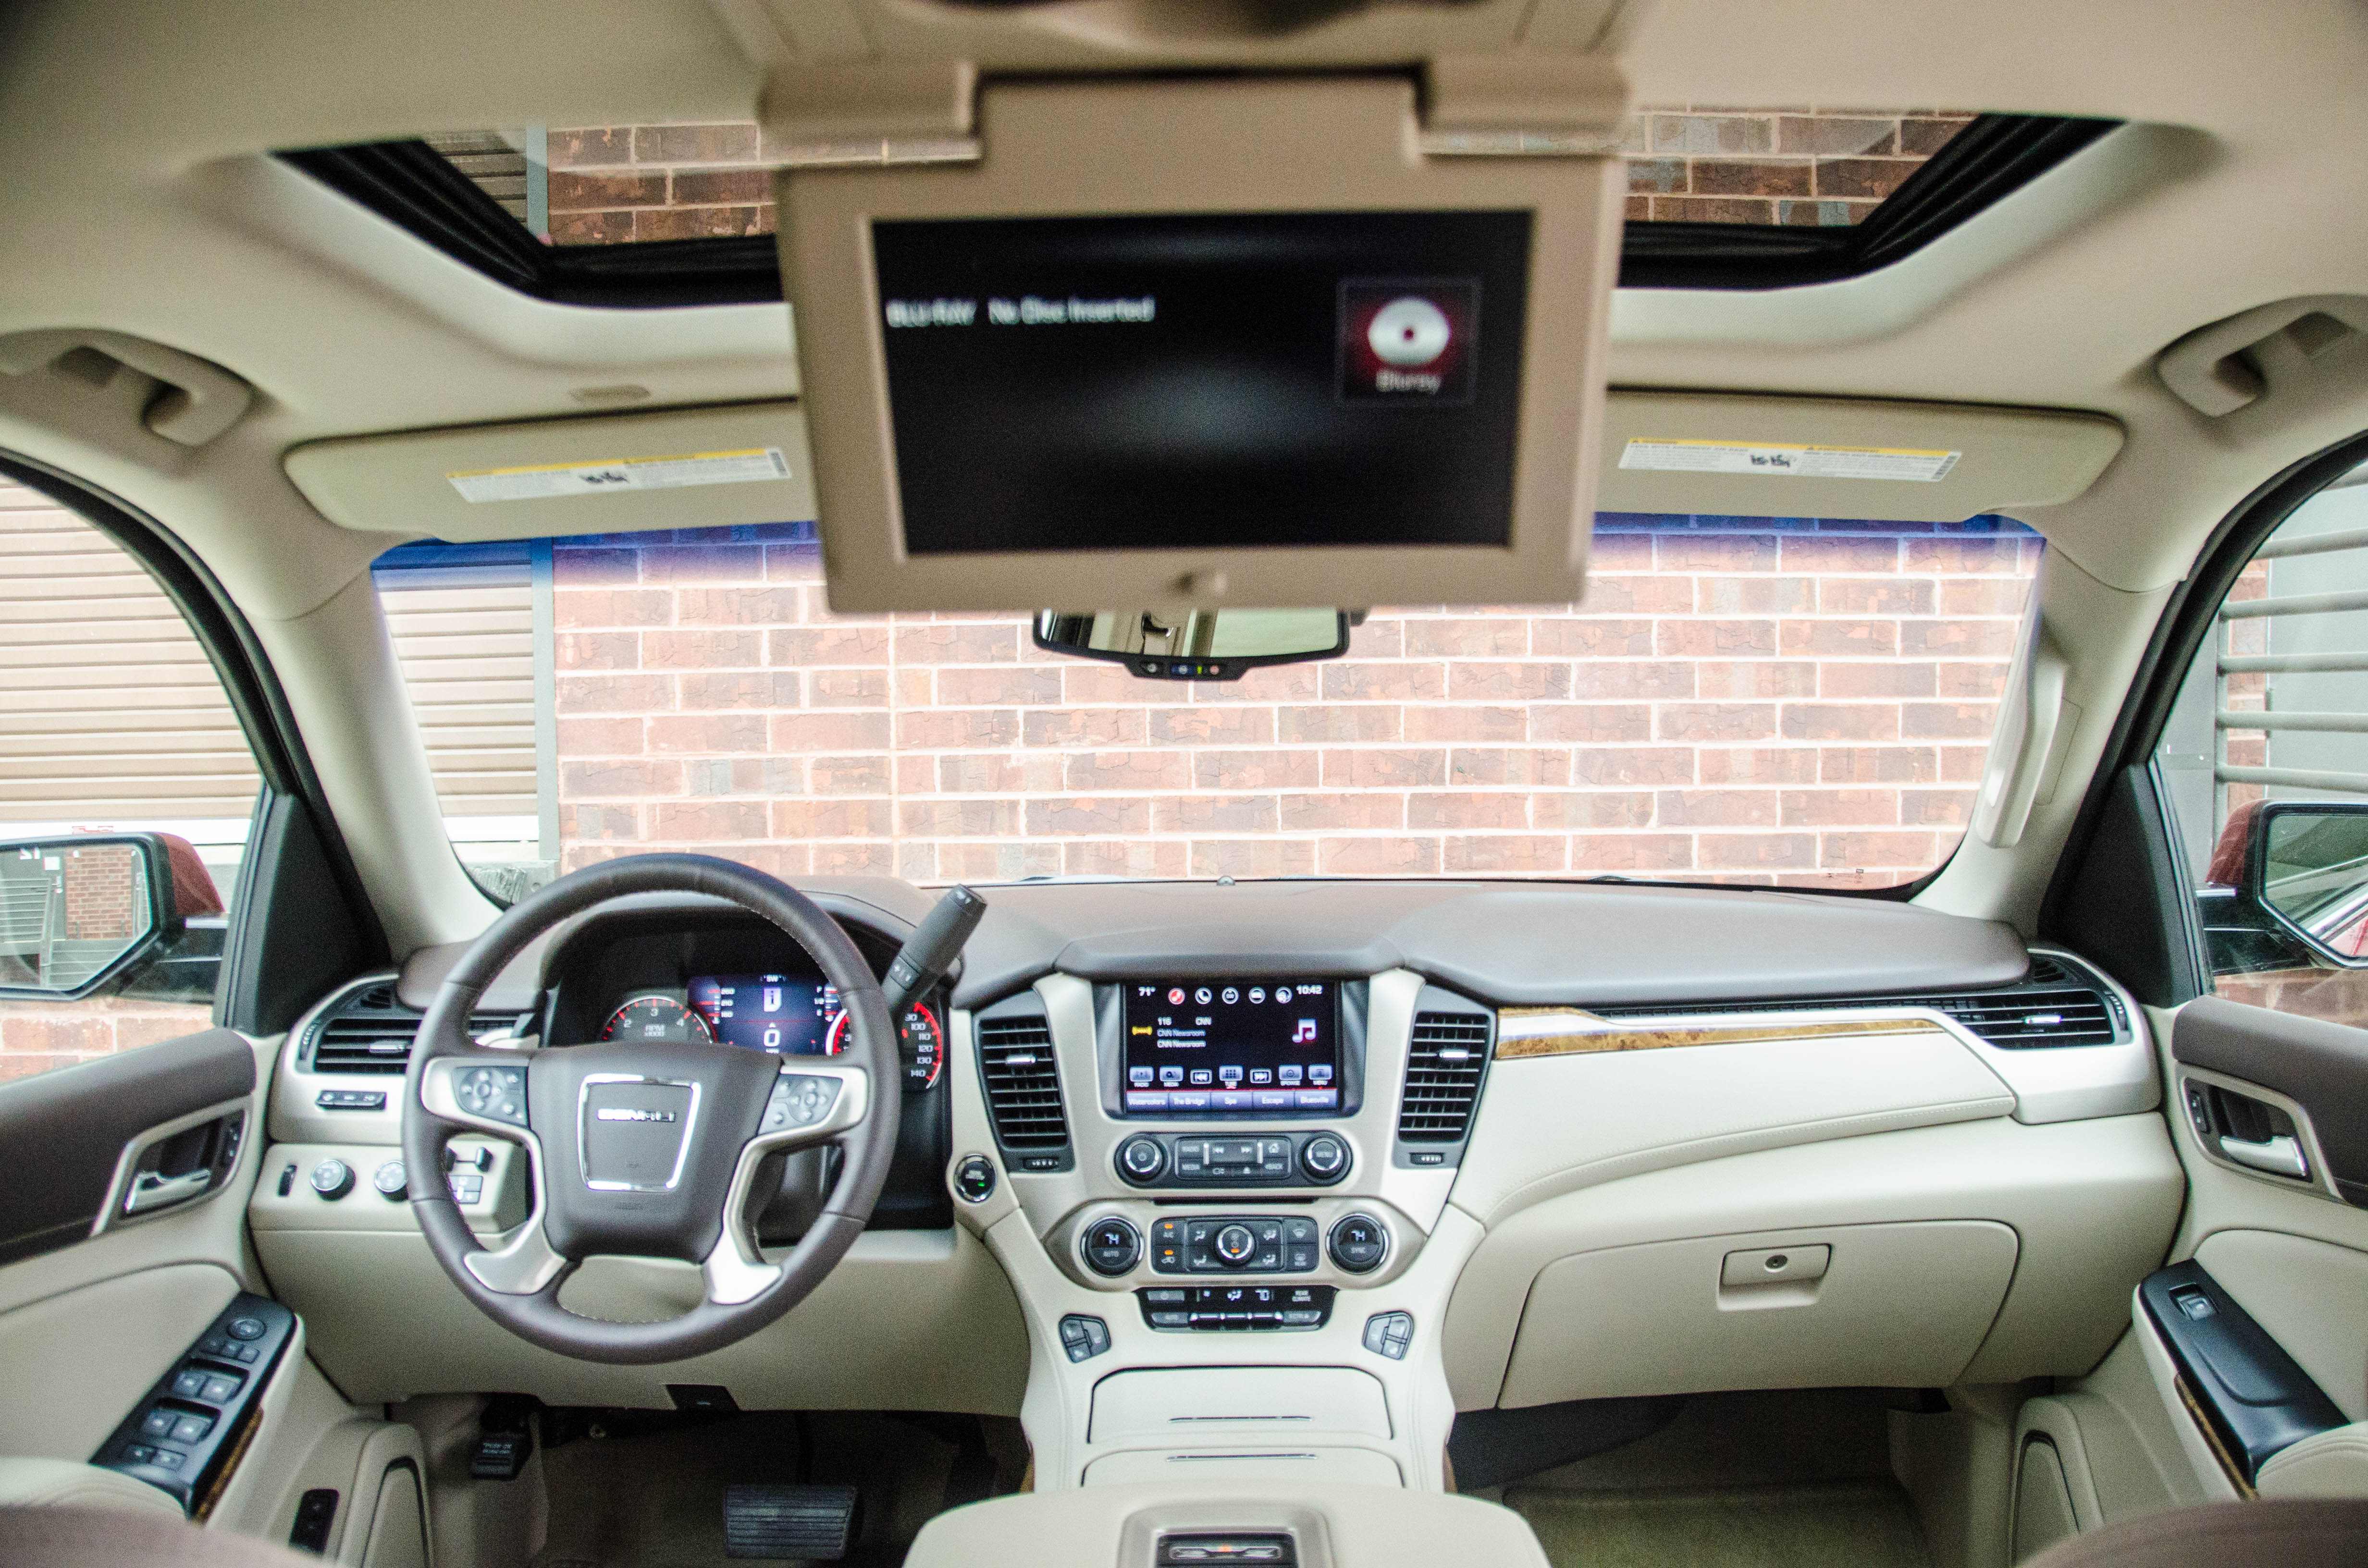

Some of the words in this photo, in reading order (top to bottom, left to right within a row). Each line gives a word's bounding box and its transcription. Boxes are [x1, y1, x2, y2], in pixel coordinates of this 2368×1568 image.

[1296, 985, 1322, 994] 10:42
[651, 1007, 658, 1017] 3
[911, 1022, 926, 1031] 100
[917, 1056, 932, 1065] 130
